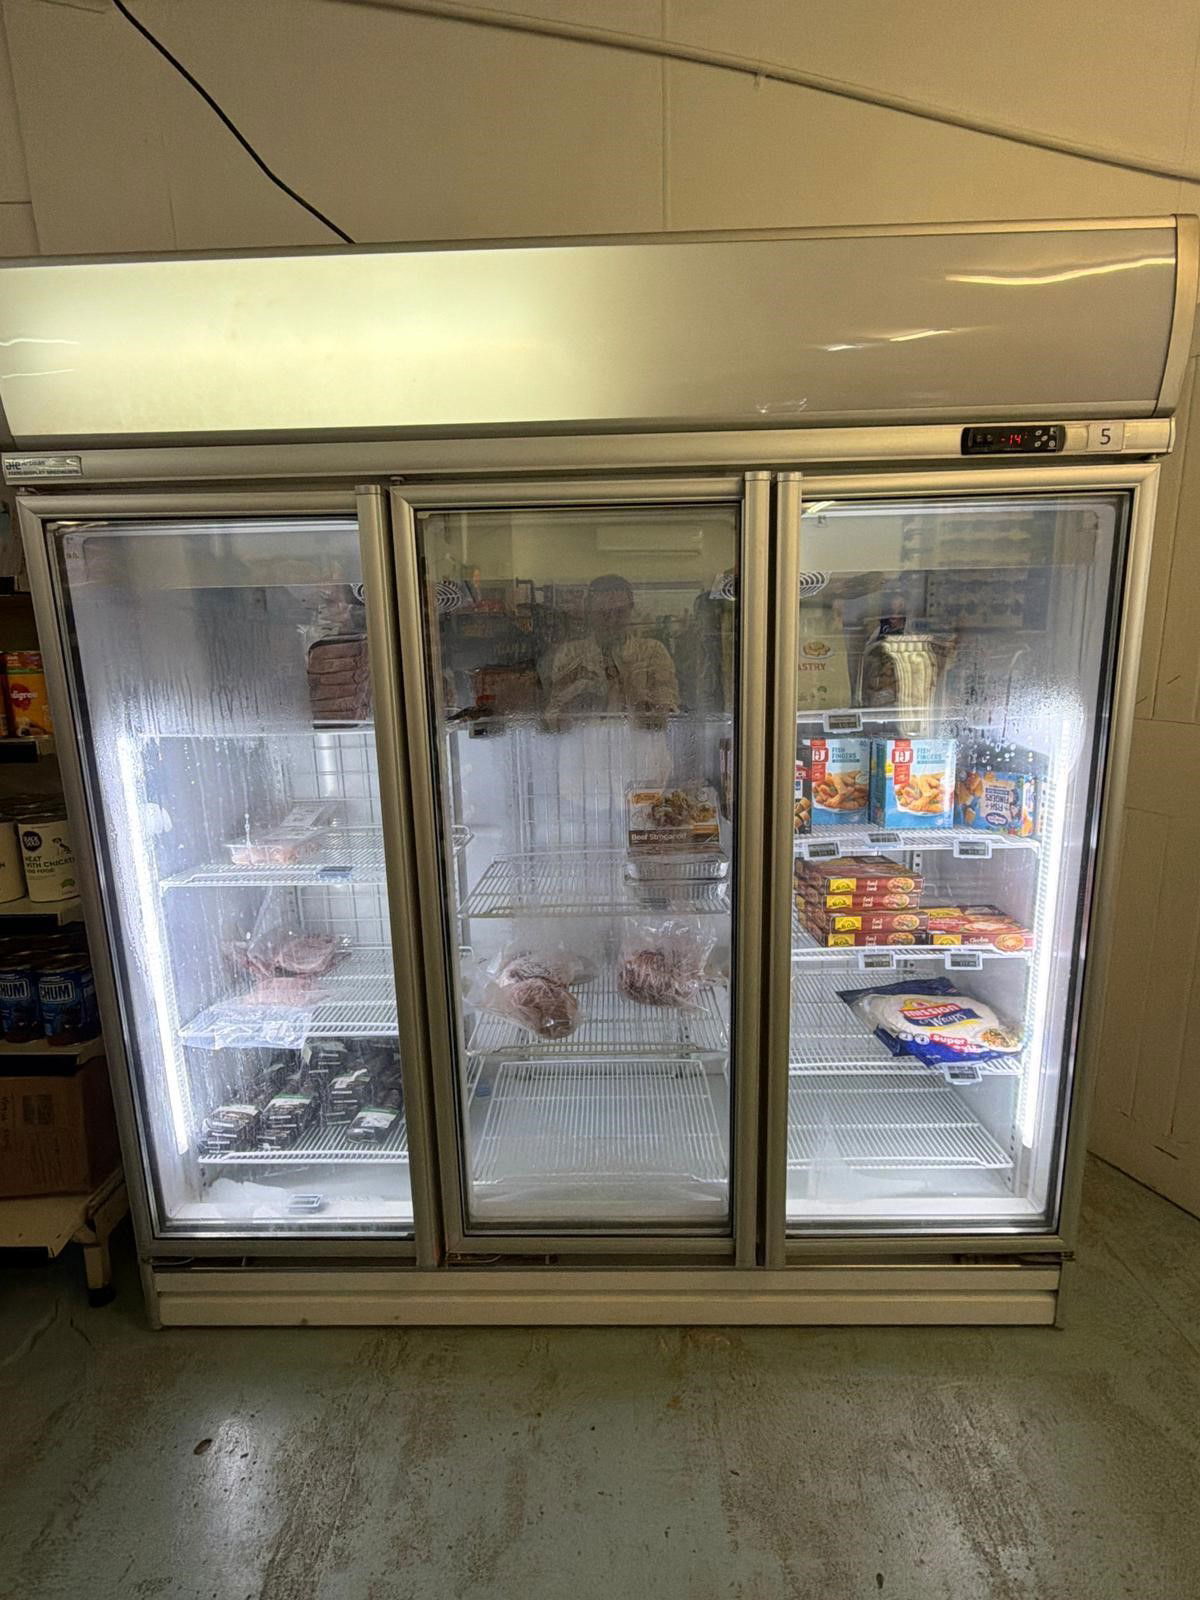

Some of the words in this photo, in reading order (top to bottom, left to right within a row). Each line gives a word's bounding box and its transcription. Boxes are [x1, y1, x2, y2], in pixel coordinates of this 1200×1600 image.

[1100, 428, 1111, 445] 5
[798, 663, 826, 671] ASTRY
[0, 983, 30, 998] HUM
[39, 983, 73, 1000] CHUM
[933, 1034, 966, 1046] Super
